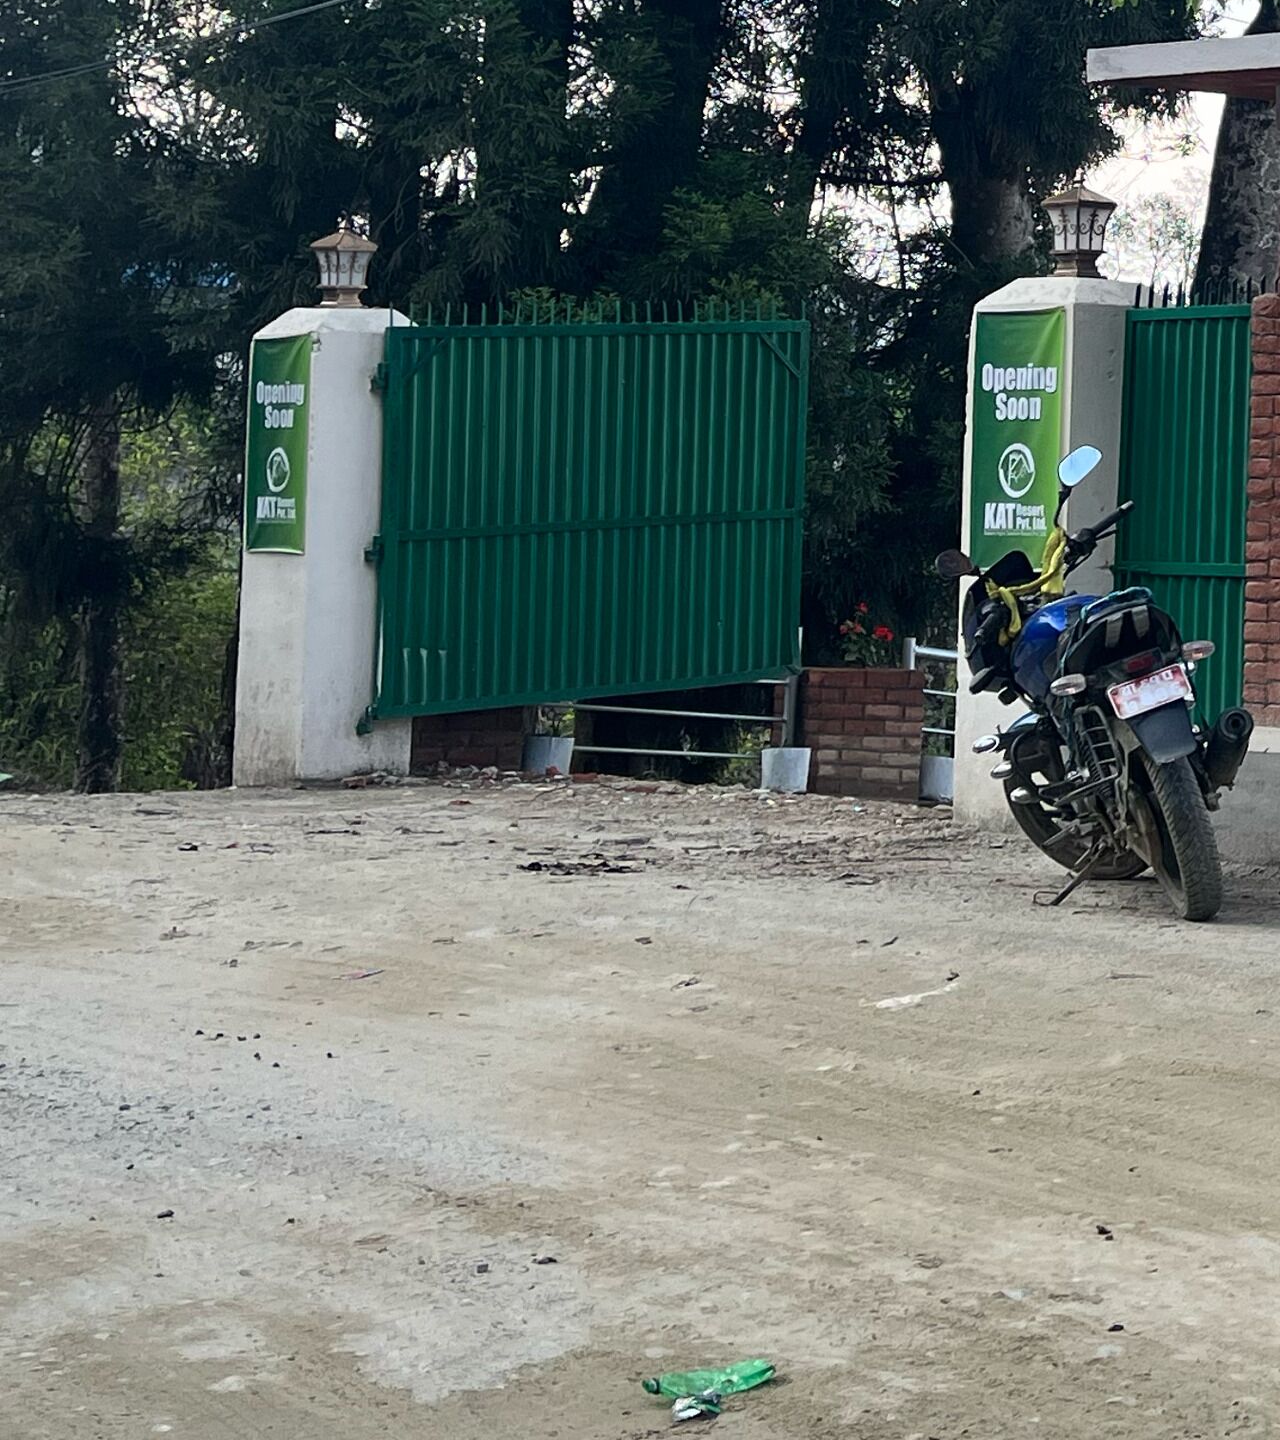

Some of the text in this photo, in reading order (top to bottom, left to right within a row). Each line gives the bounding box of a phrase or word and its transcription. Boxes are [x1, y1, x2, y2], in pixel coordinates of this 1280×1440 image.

[982, 363, 1058, 393] Opening
[256, 380, 305, 406] Opening
[264, 405, 295, 429] Soon
[995, 393, 1042, 420] Soon
[257, 496, 277, 518] KAT
[984, 502, 1016, 529] KAT
